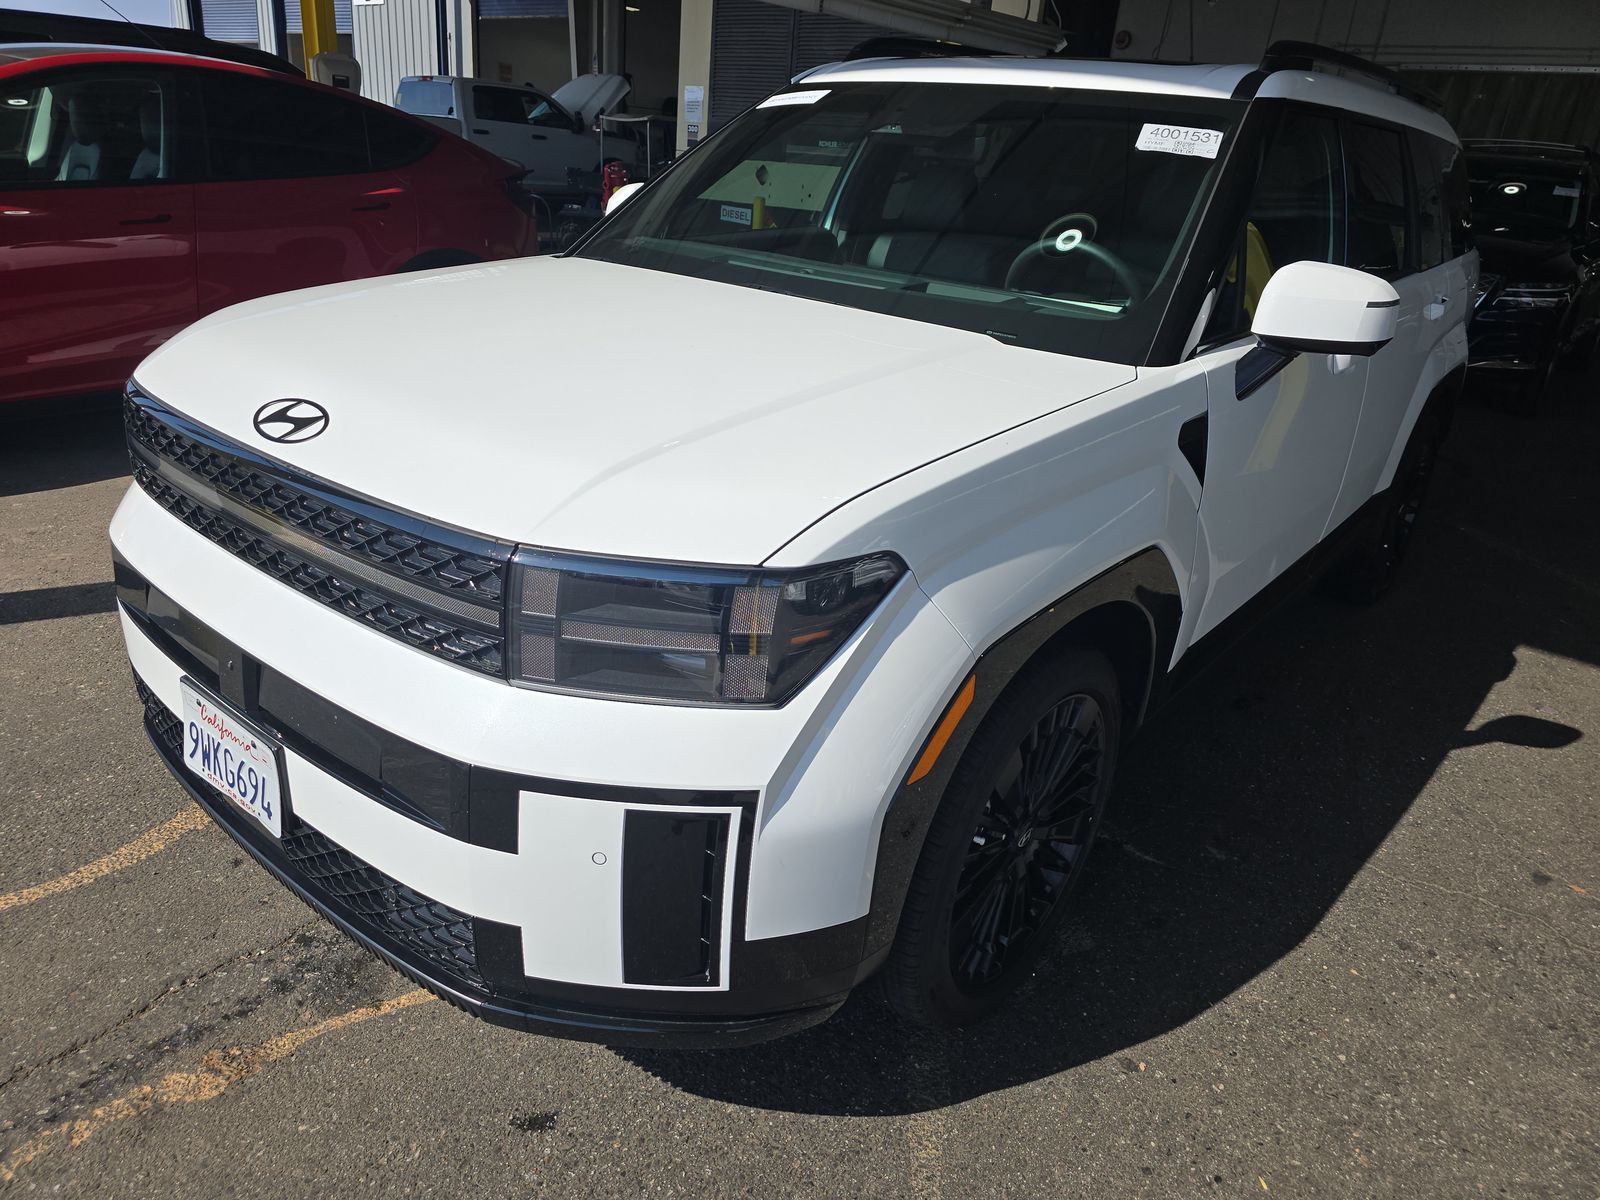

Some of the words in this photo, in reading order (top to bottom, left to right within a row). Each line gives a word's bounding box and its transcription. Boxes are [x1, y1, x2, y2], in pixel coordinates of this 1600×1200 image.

[1150, 127, 1220, 144] 4001531
[721, 207, 750, 222] DIESEL
[201, 703, 255, 757] California
[189, 721, 273, 820] 9WKG694
[207, 772, 256, 814] dmv.ca.gov
